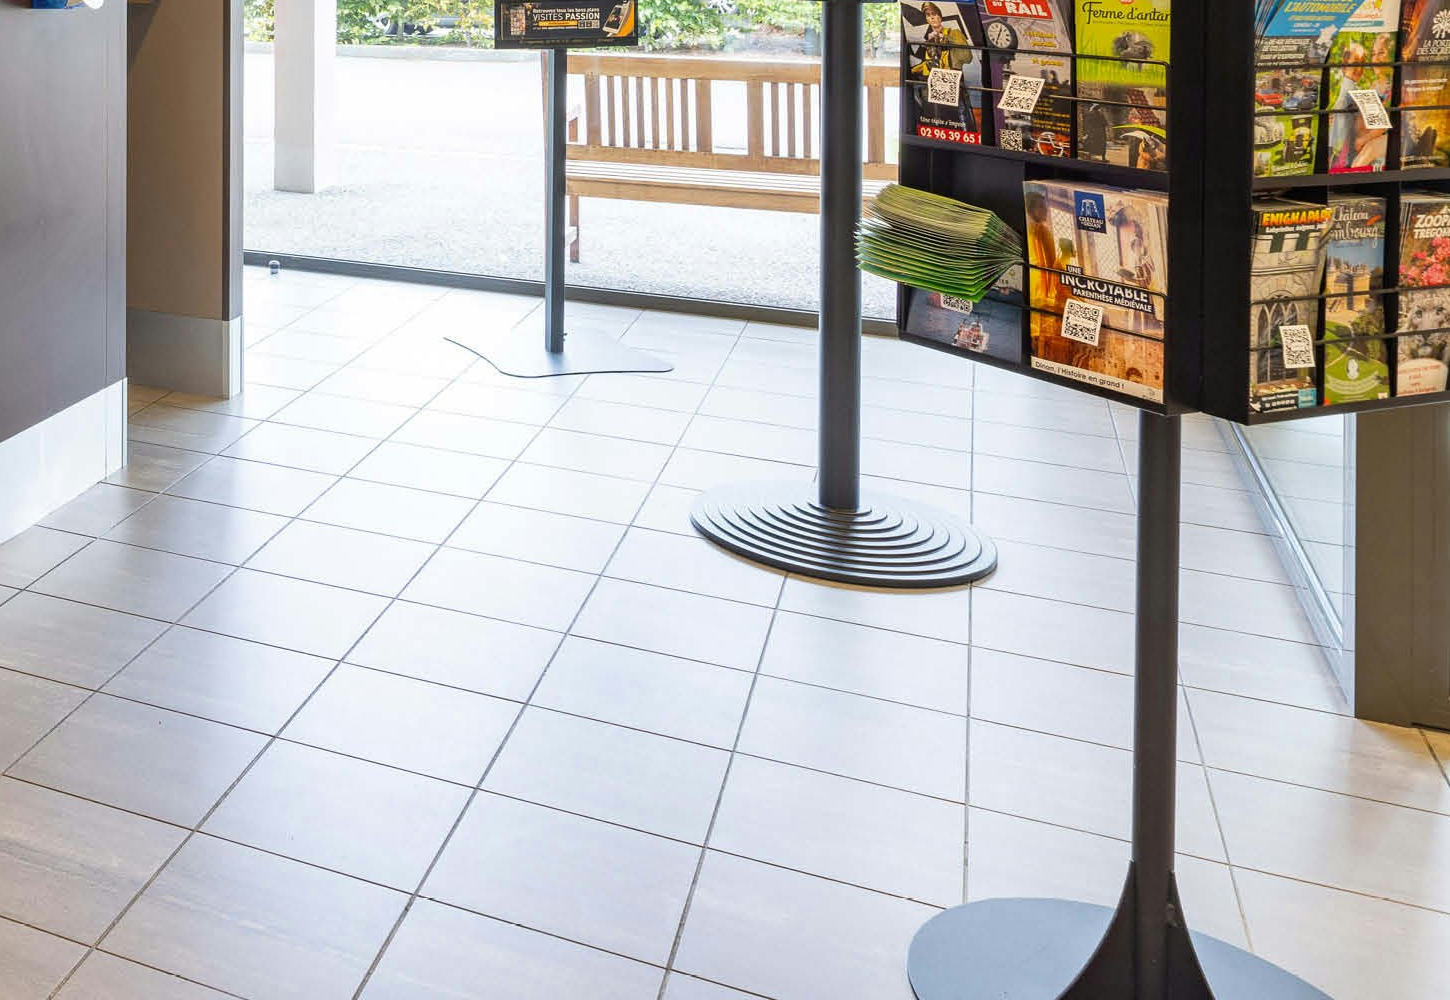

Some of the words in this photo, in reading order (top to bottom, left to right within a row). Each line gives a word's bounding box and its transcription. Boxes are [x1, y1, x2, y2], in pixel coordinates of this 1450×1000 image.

[1005, 1, 1048, 17] RAIL
[1082, 1, 1125, 25] Ferme
[1283, 1, 1358, 13] L'AUTOMOBILE
[532, 13, 563, 21] VISITES
[565, 12, 600, 21] PASSION
[920, 127, 932, 137] 02
[934, 129, 946, 139] 96
[948, 131, 961, 141] 39
[963, 133, 975, 143] 65
[1078, 216, 1104, 225] CHÂTEAU
[1067, 265, 1082, 275] UNE
[1061, 273, 1148, 302] INCROYABLE
[1073, 287, 1113, 303] PARENTHÈSE
[1114, 297, 1152, 312] MÉDIÉVALE
[1099, 378, 1120, 389] grand
